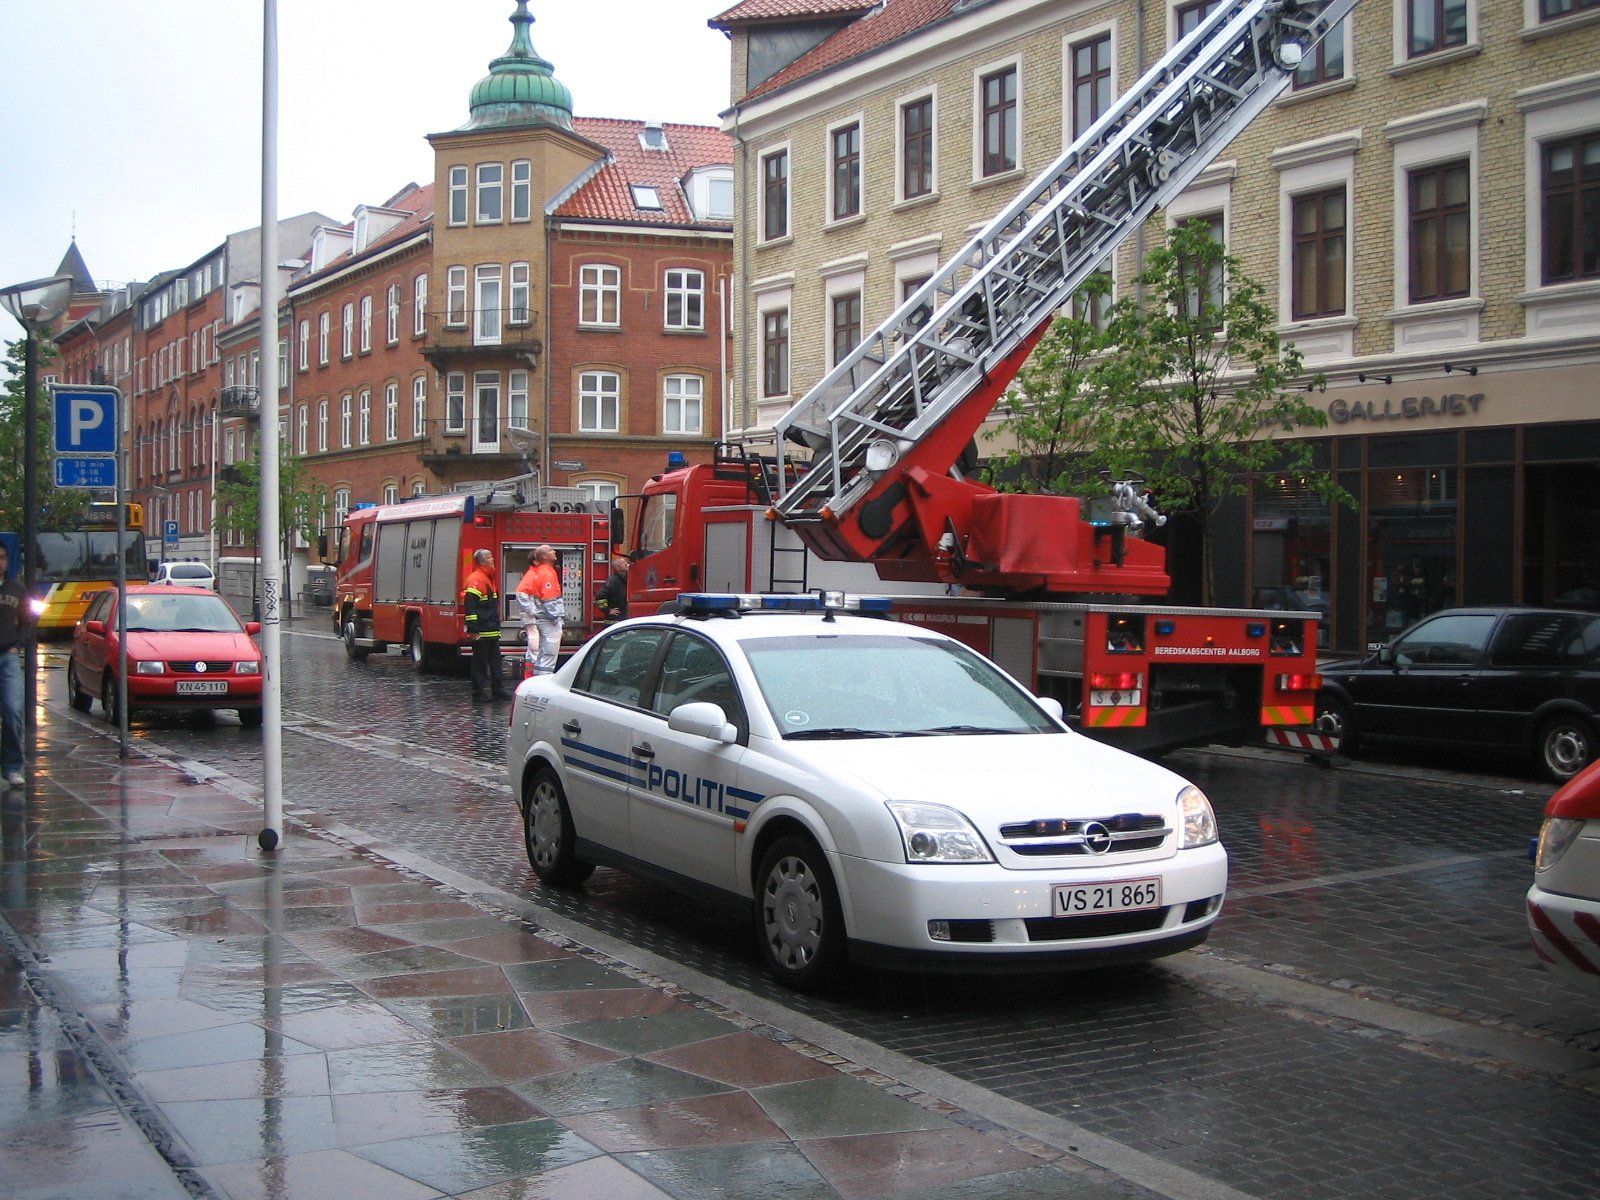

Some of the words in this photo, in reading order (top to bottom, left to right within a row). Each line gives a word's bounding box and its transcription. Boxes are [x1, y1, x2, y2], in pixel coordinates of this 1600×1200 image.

[71, 400, 104, 446] P
[1328, 393, 1485, 424] GALLERIET
[168, 523, 176, 534] P
[1154, 646, 1227, 656] BEREDSKABSCENTER
[1228, 648, 1260, 656] AALBORG
[648, 763, 724, 813] POLITI
[1058, 889, 1087, 911] VS
[1093, 887, 1113, 908] 21
[1121, 883, 1156, 907] 865
